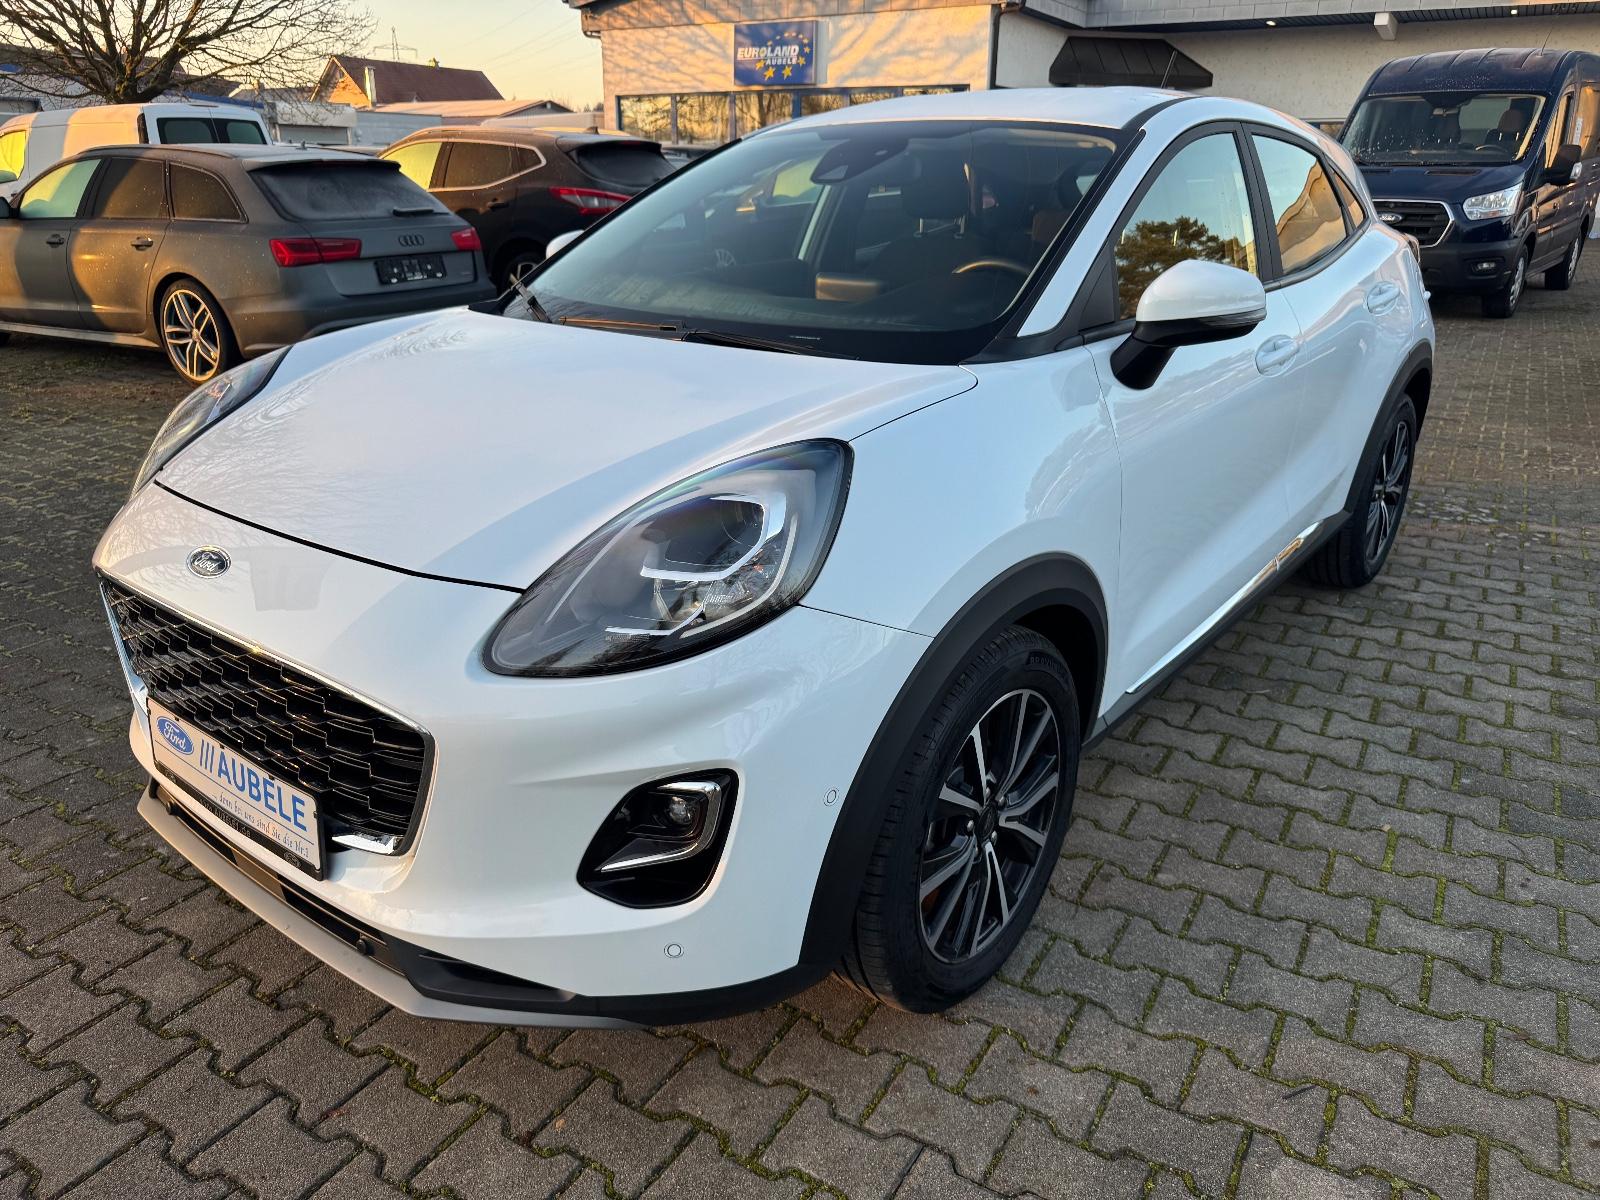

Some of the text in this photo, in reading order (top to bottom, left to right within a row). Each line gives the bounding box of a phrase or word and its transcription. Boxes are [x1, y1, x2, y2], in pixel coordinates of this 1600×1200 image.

[737, 45, 799, 58] EUROLAND
[766, 57, 798, 65] AUBELE
[163, 721, 187, 750] Ford
